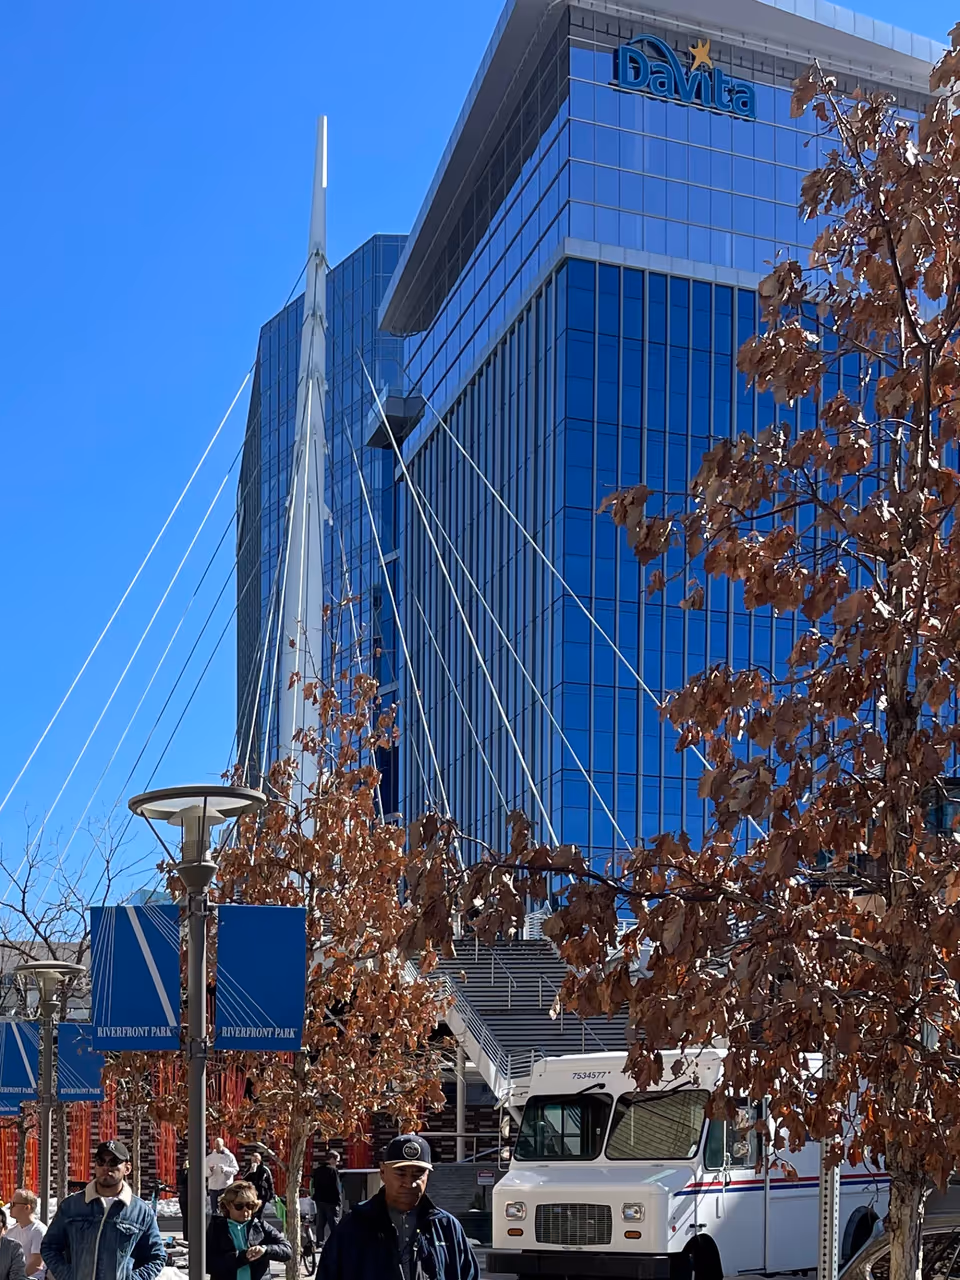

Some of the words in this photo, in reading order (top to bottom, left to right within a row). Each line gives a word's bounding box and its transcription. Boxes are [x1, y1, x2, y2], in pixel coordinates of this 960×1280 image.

[618, 33, 756, 119] DaVita
[97, 1026, 149, 1038] RIVERFRONT
[151, 1026, 173, 1038] PARK
[221, 1026, 274, 1038] RIVERFRONT
[275, 1027, 296, 1039] PARK
[572, 1071, 607, 1080] 7534577
